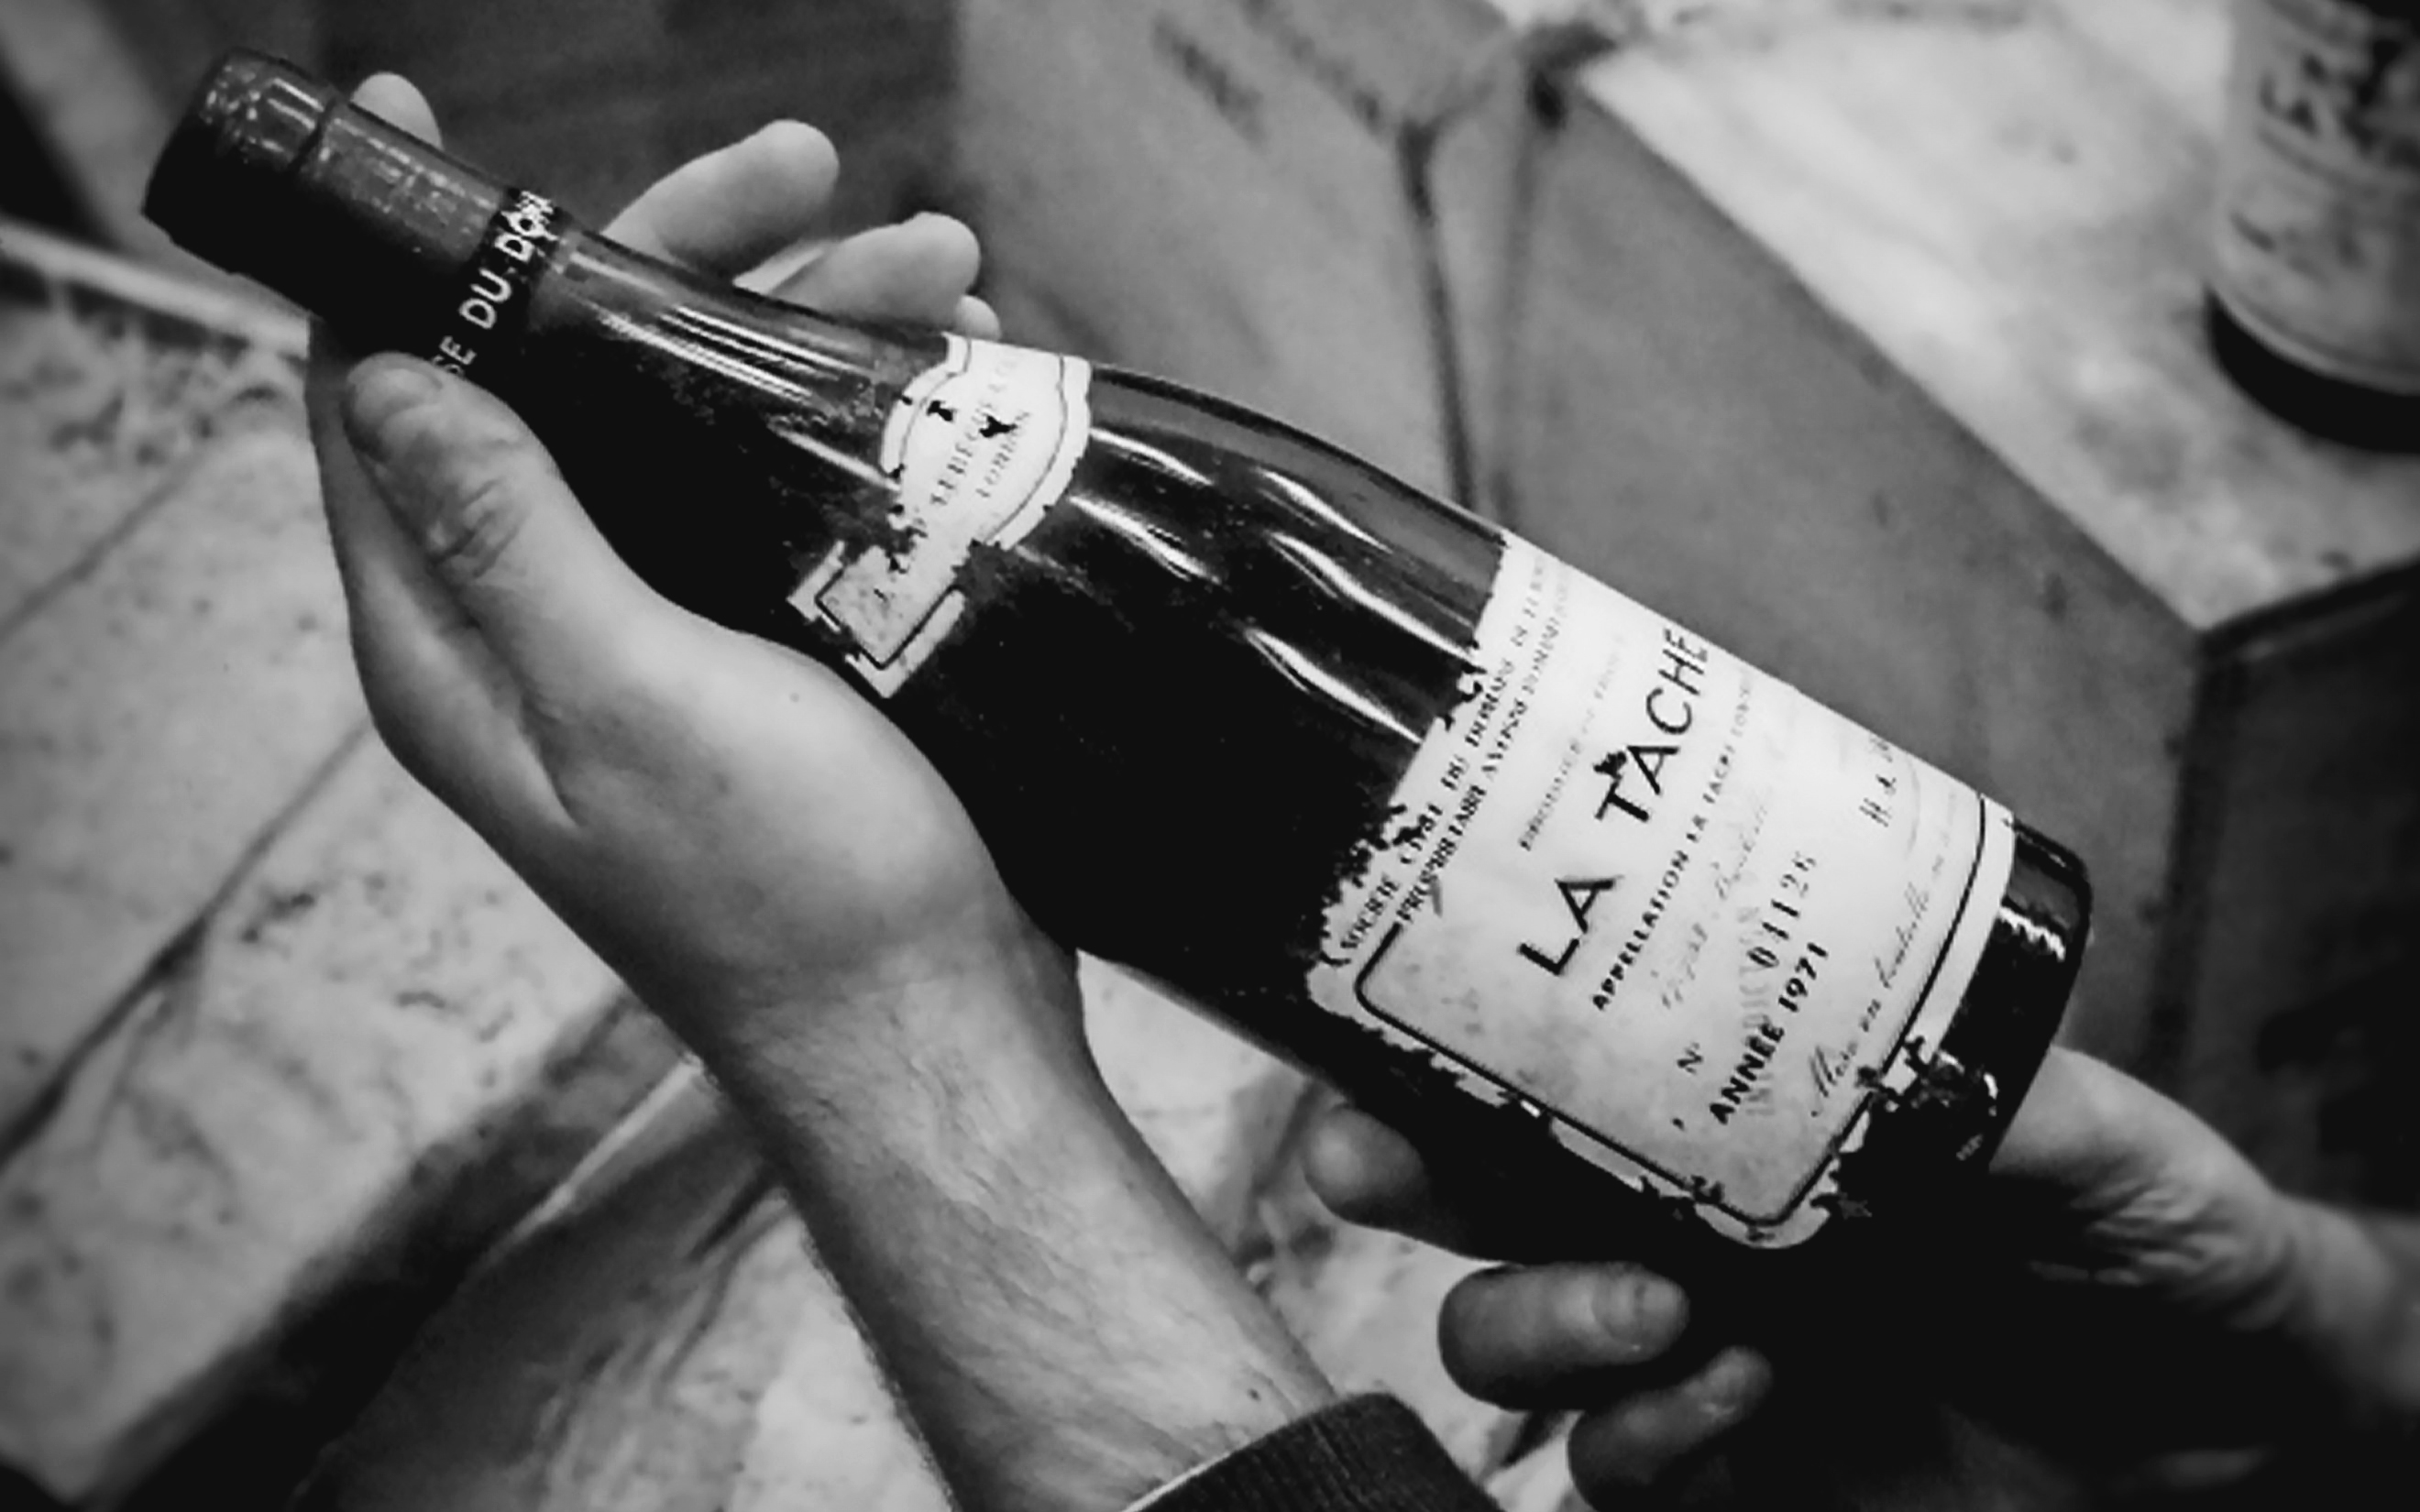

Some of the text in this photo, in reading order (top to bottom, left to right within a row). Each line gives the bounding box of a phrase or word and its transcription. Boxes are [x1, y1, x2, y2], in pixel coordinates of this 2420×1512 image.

[458, 268, 512, 329] DU
[1514, 879, 1614, 976] LA
[1588, 848, 1691, 1012] APPELLATION
[1776, 944, 1830, 1014] 1971
